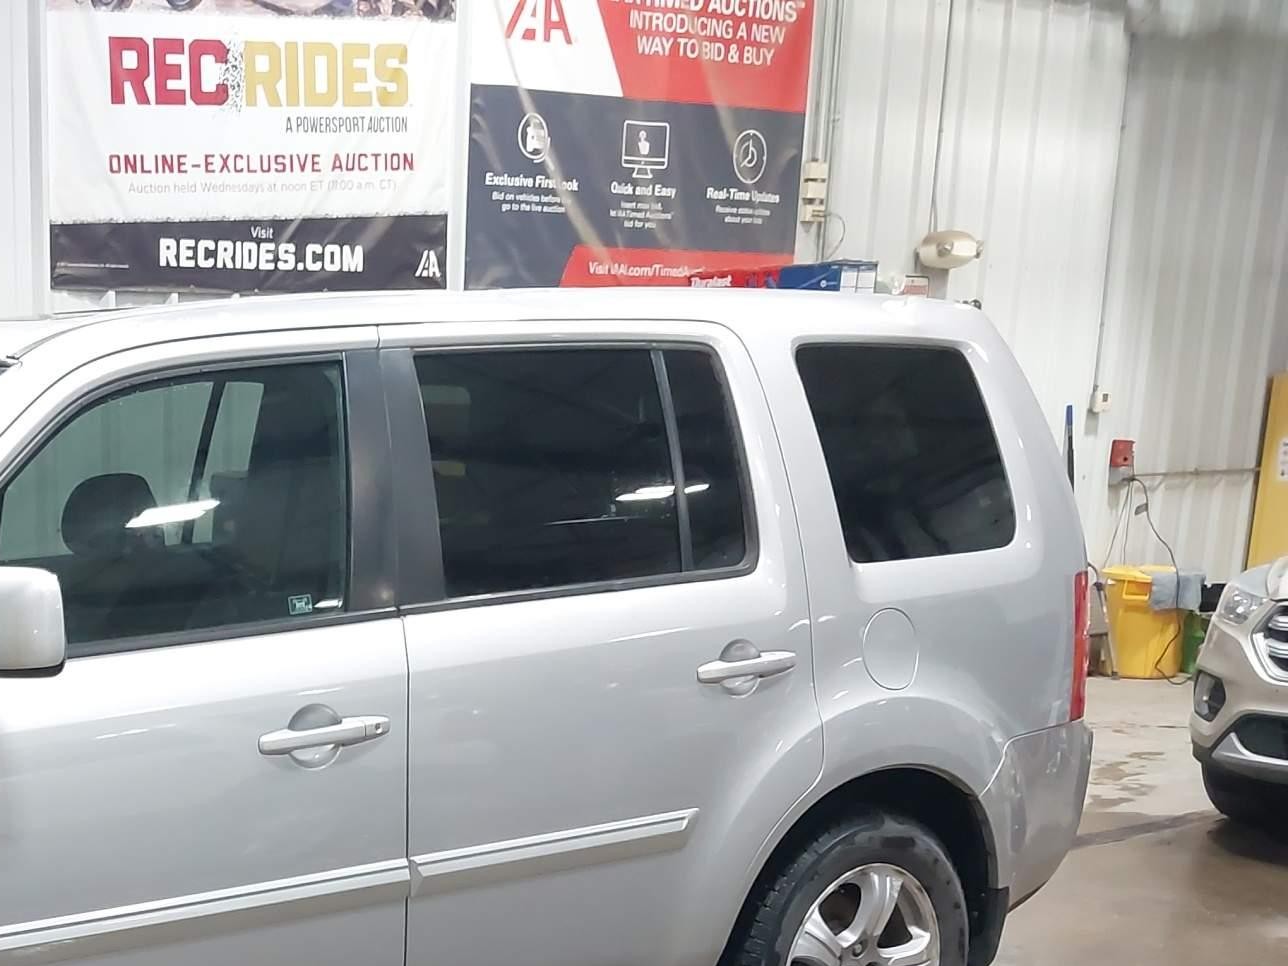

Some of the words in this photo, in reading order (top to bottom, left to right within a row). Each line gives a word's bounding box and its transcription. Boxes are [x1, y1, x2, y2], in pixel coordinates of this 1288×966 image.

[630, 9, 734, 40] INTRODUCING
[736, 22, 748, 40] A
[751, 25, 786, 44] NEW
[637, 35, 674, 56] WAY
[677, 37, 700, 59] TO
[702, 41, 725, 62] BID
[727, 43, 740, 63] &
[743, 46, 776, 66] BUY
[108, 36, 230, 106] REC
[242, 40, 410, 108] RIDES
[285, 116, 293, 133] A
[296, 116, 365, 133] POWERSPORT
[367, 116, 409, 133] AUCTION
[108, 153, 322, 174] ONLINE-EXCLUSIVE
[331, 152, 415, 173] AUCTION
[128, 182, 170, 194] Auction
[173, 182, 197, 193] held
[200, 182, 265, 195] Wednesdays
[266, 182, 277, 192] at
[280, 181, 307, 191] noon
[310, 180, 324, 191] ET
[485, 171, 533, 187] Exclusive
[611, 181, 634, 195] Quick
[635, 184, 652, 196] and
[654, 183, 677, 199] Easy
[706, 187, 751, 201] Real-Time
[251, 226, 274, 239] Visit
[159, 238, 364, 273] RECRIDES.COM
